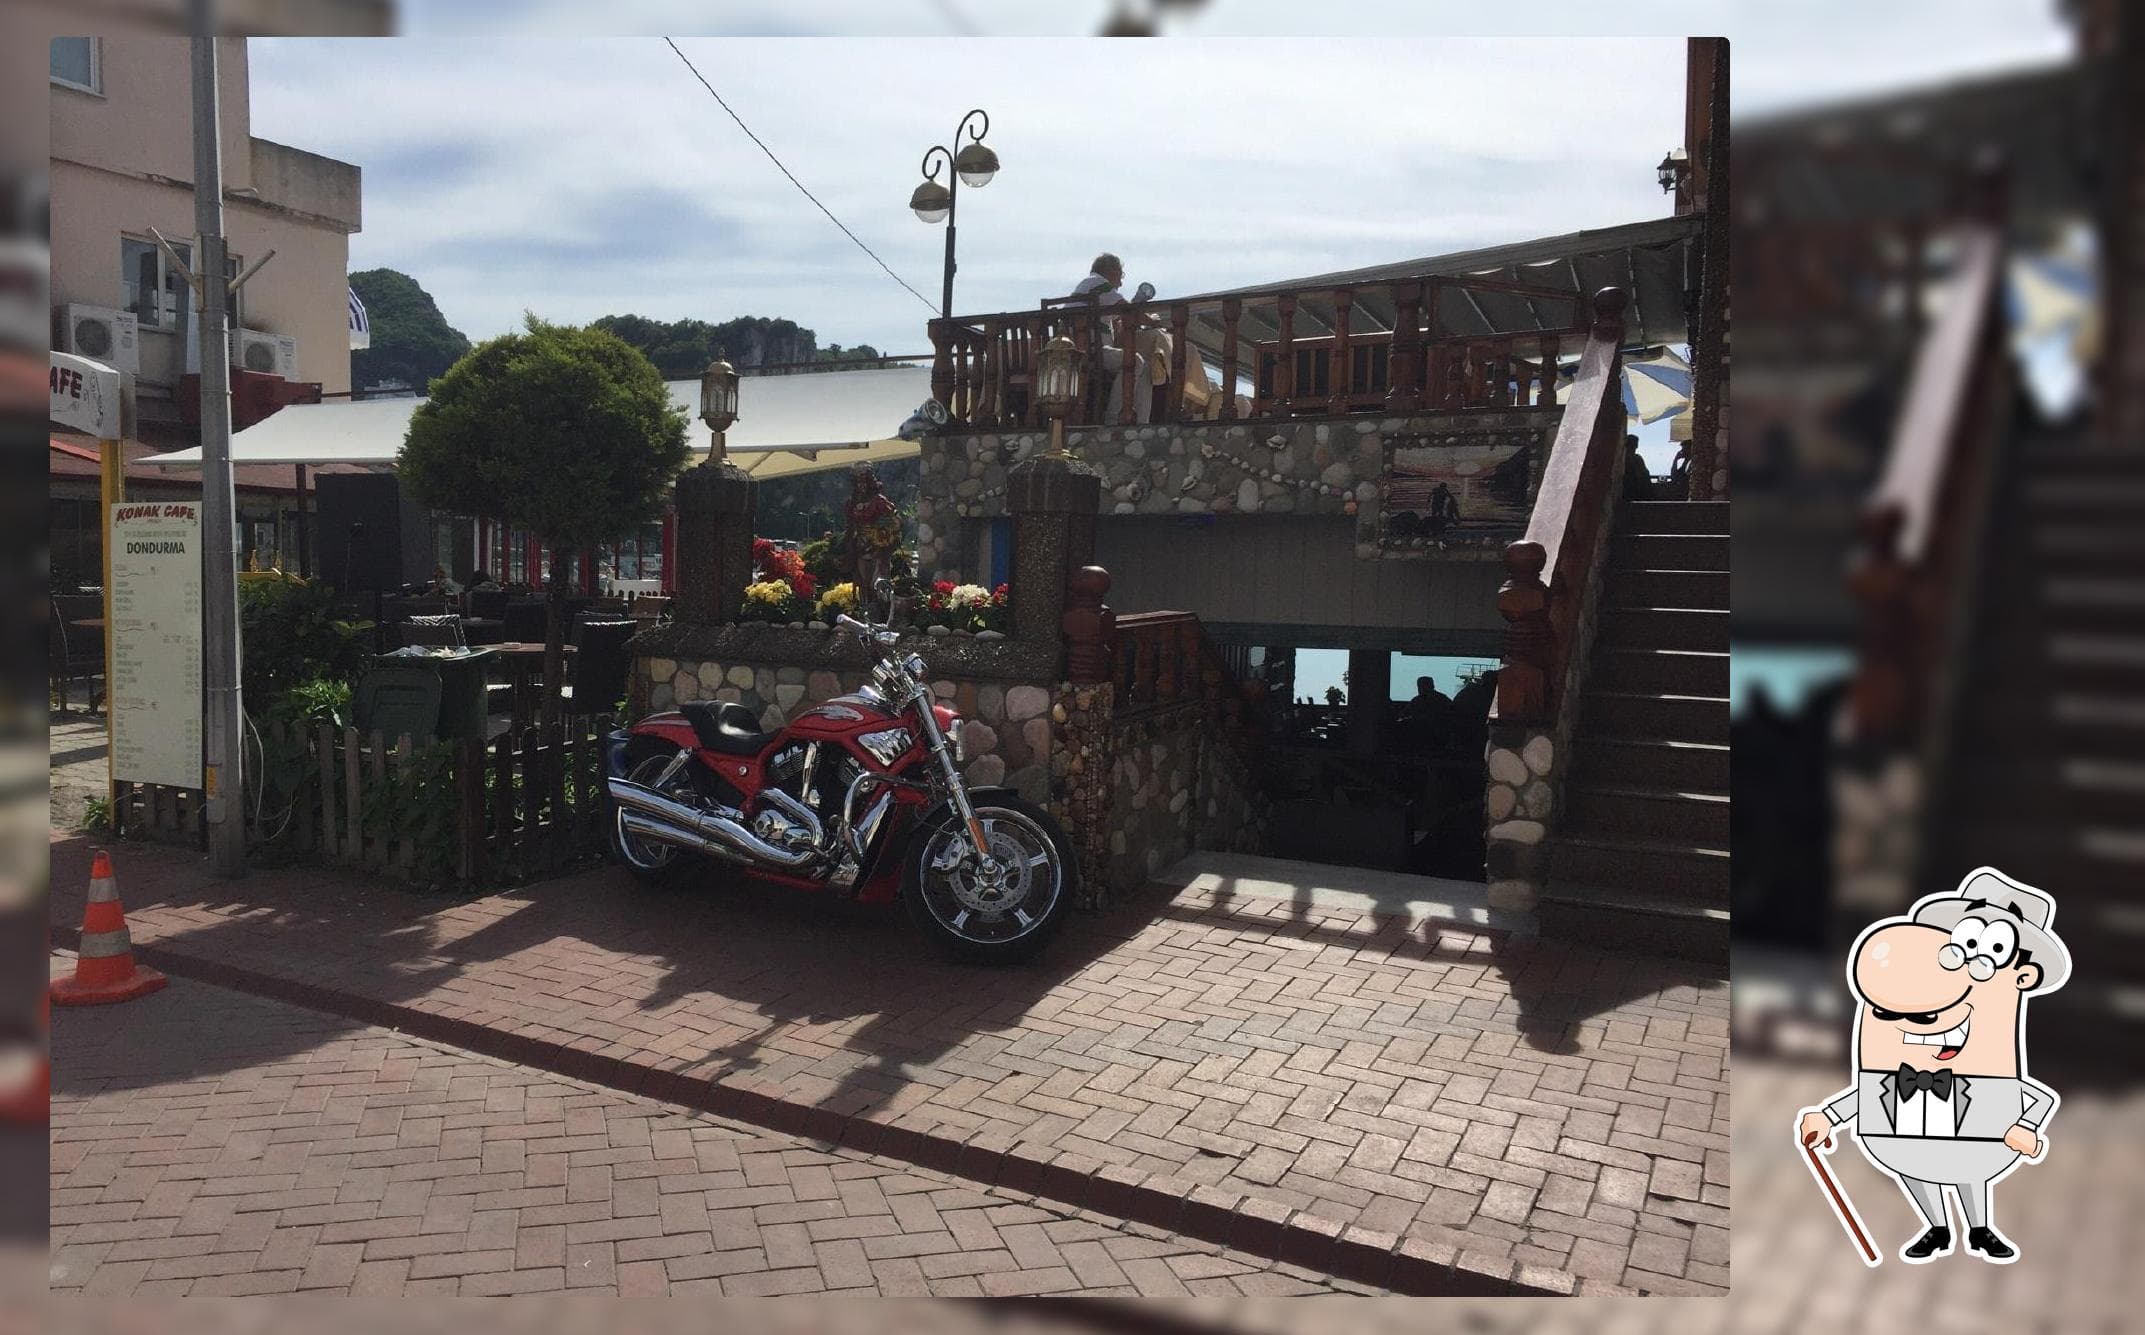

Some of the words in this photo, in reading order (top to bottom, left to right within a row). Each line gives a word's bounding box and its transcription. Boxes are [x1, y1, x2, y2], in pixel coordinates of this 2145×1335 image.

[117, 505, 161, 521] KONAK
[163, 505, 195, 519] CAFE
[126, 541, 185, 554] DONDURMA
